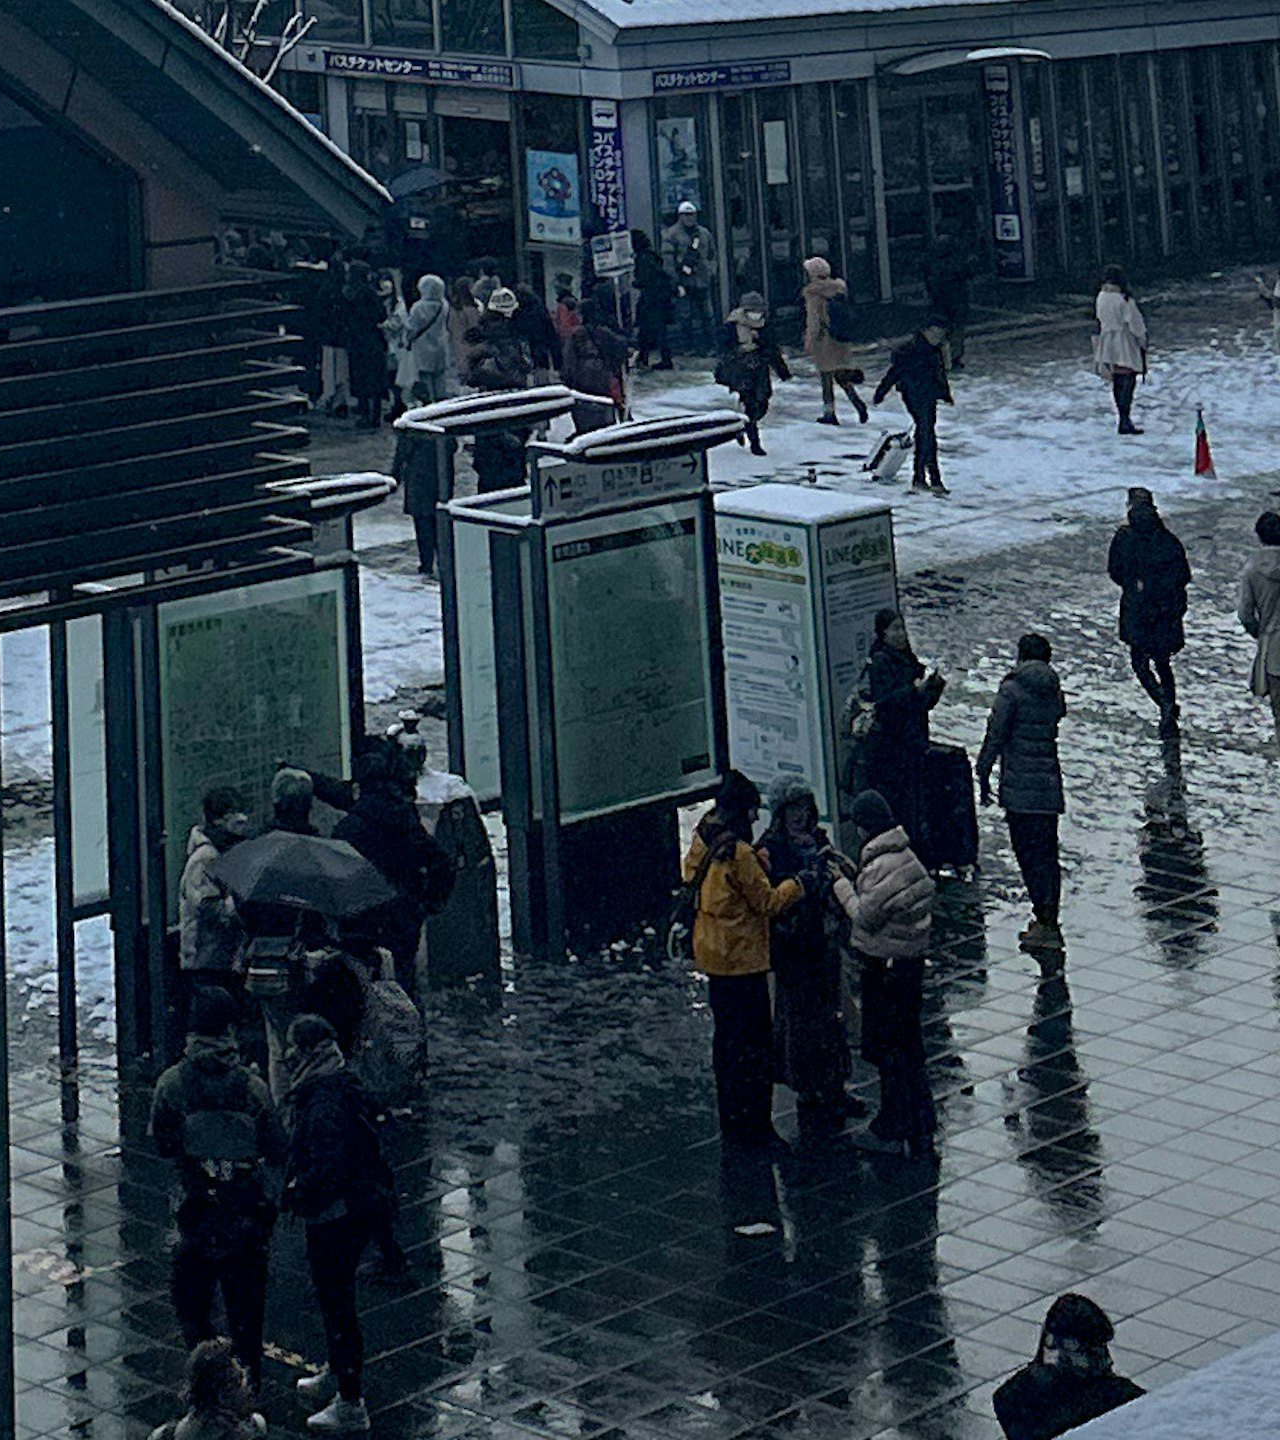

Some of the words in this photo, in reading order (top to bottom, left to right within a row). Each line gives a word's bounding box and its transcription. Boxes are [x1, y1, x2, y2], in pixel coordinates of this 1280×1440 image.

[328, 53, 424, 75] バスチケットセンター
